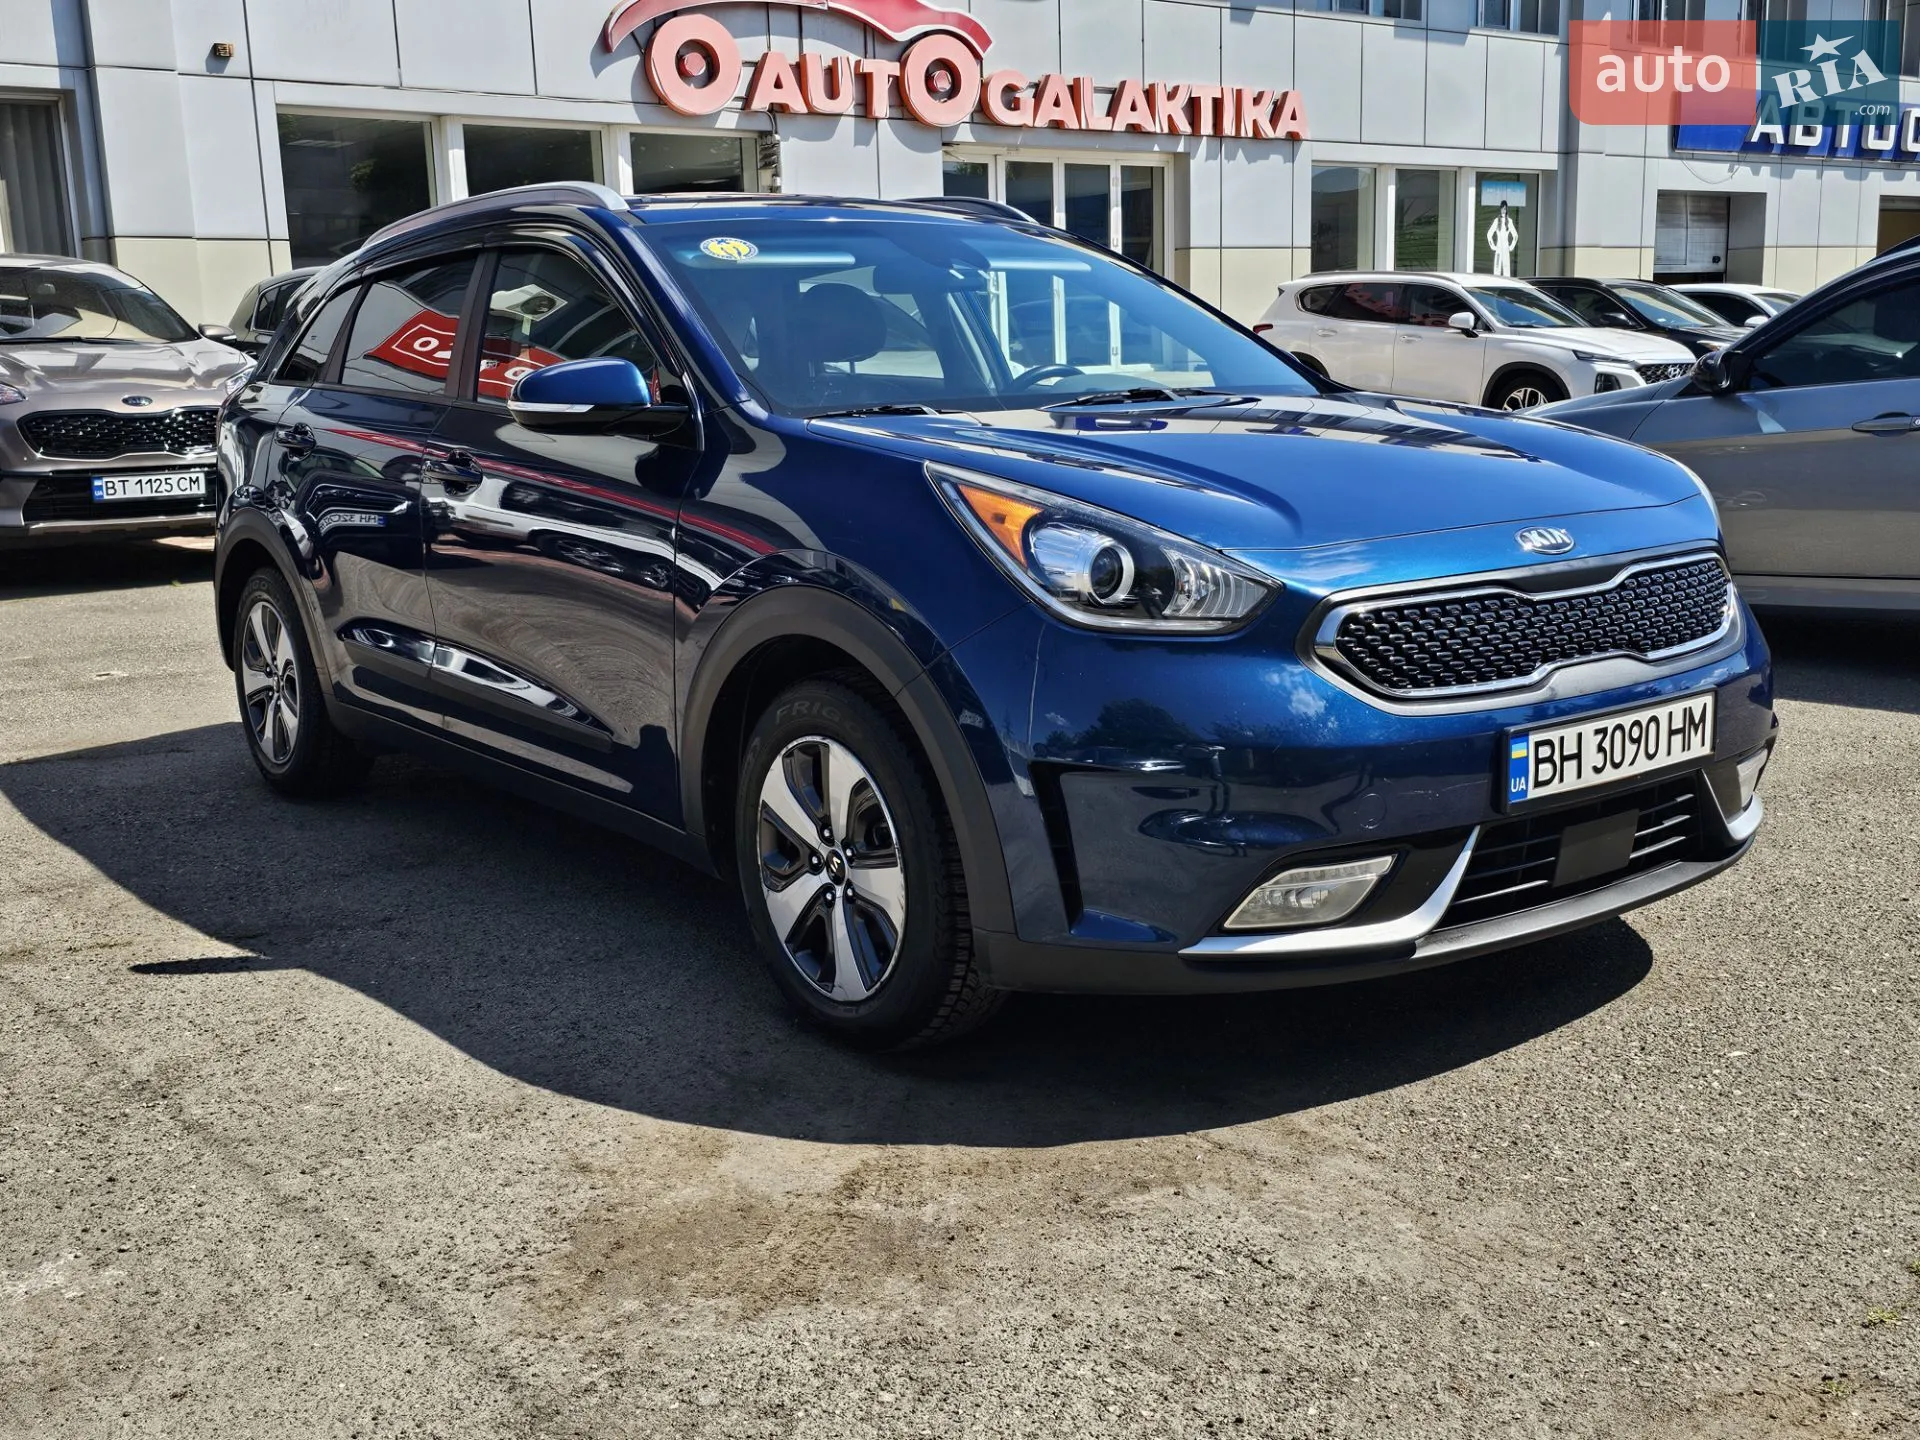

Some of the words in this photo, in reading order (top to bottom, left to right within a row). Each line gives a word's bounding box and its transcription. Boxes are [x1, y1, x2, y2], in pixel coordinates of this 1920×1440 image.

[981, 69, 1308, 141] GALAKTIKA
[105, 480, 129, 496] BT
[135, 478, 173, 495] 1125
[177, 476, 200, 491] CM
[1523, 528, 1566, 549] KIA
[1533, 731, 1583, 789] BH
[1592, 715, 1660, 775] 3090
[1666, 702, 1707, 758] HM
[1511, 778, 1526, 793] UA
